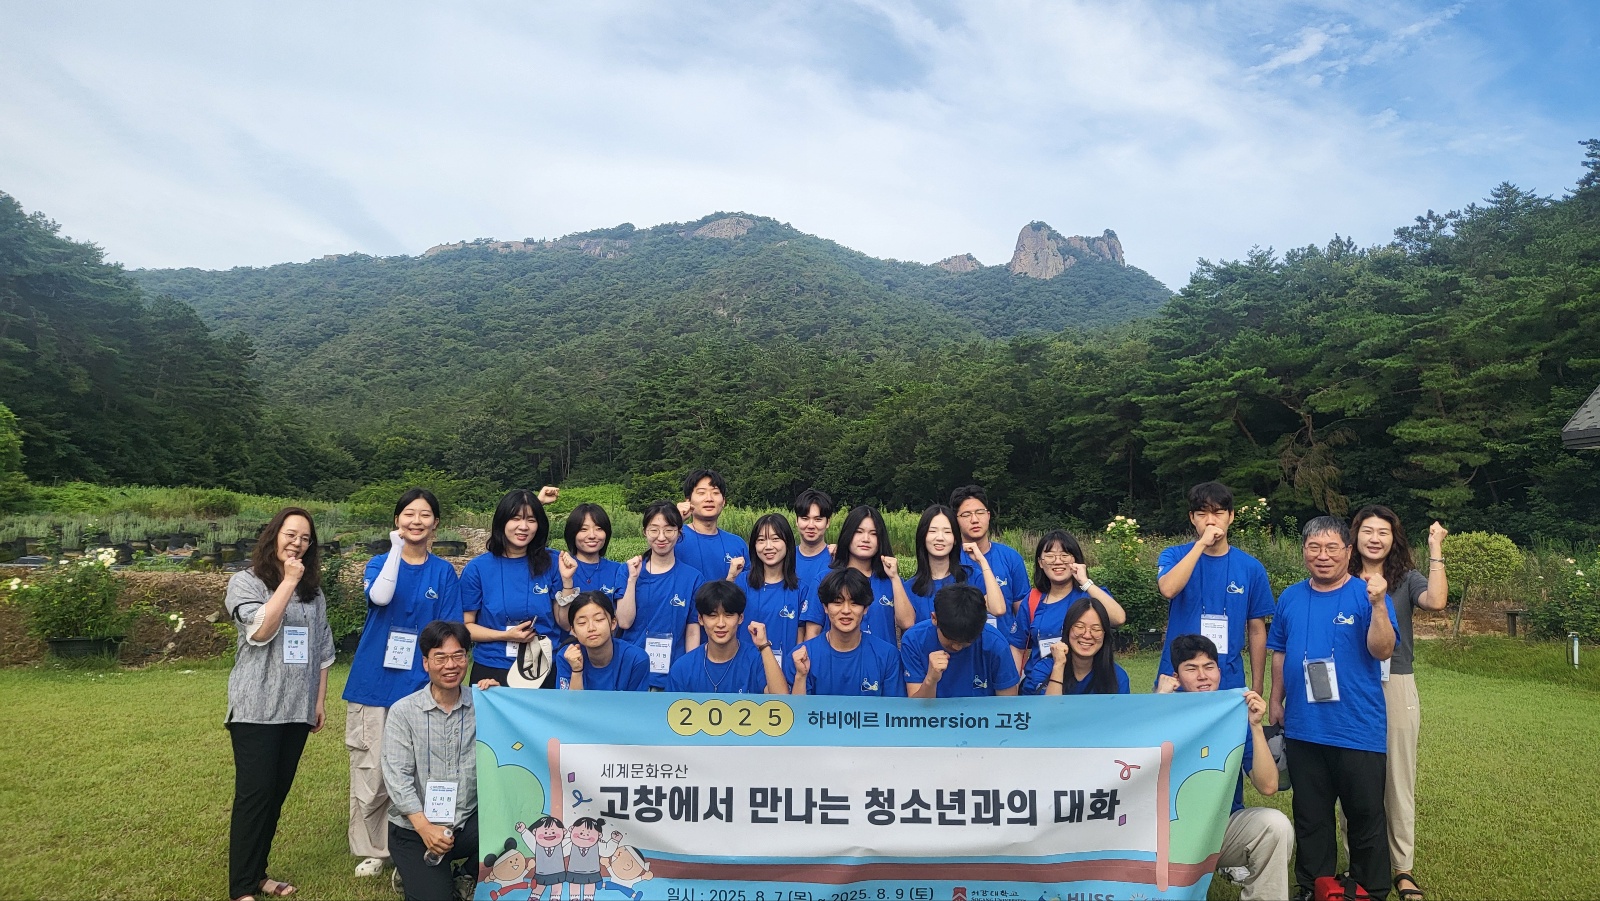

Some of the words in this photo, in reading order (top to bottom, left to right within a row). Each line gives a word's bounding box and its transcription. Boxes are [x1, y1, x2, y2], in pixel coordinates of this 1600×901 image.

[679, 707, 783, 727] 2025
[807, 709, 879, 730] 하비에르
[885, 712, 990, 729] Immersion
[994, 711, 1032, 731] 고창
[600, 763, 689, 780] 세계문화유산
[599, 785, 734, 823] 고창에서
[749, 787, 851, 825] 만나는
[864, 787, 1038, 827] 청소년과의
[1053, 788, 1121, 824] 대화
[667, 887, 695, 901] 일시
[895, 888, 905, 900] 9
[909, 887, 934, 901] (토)
